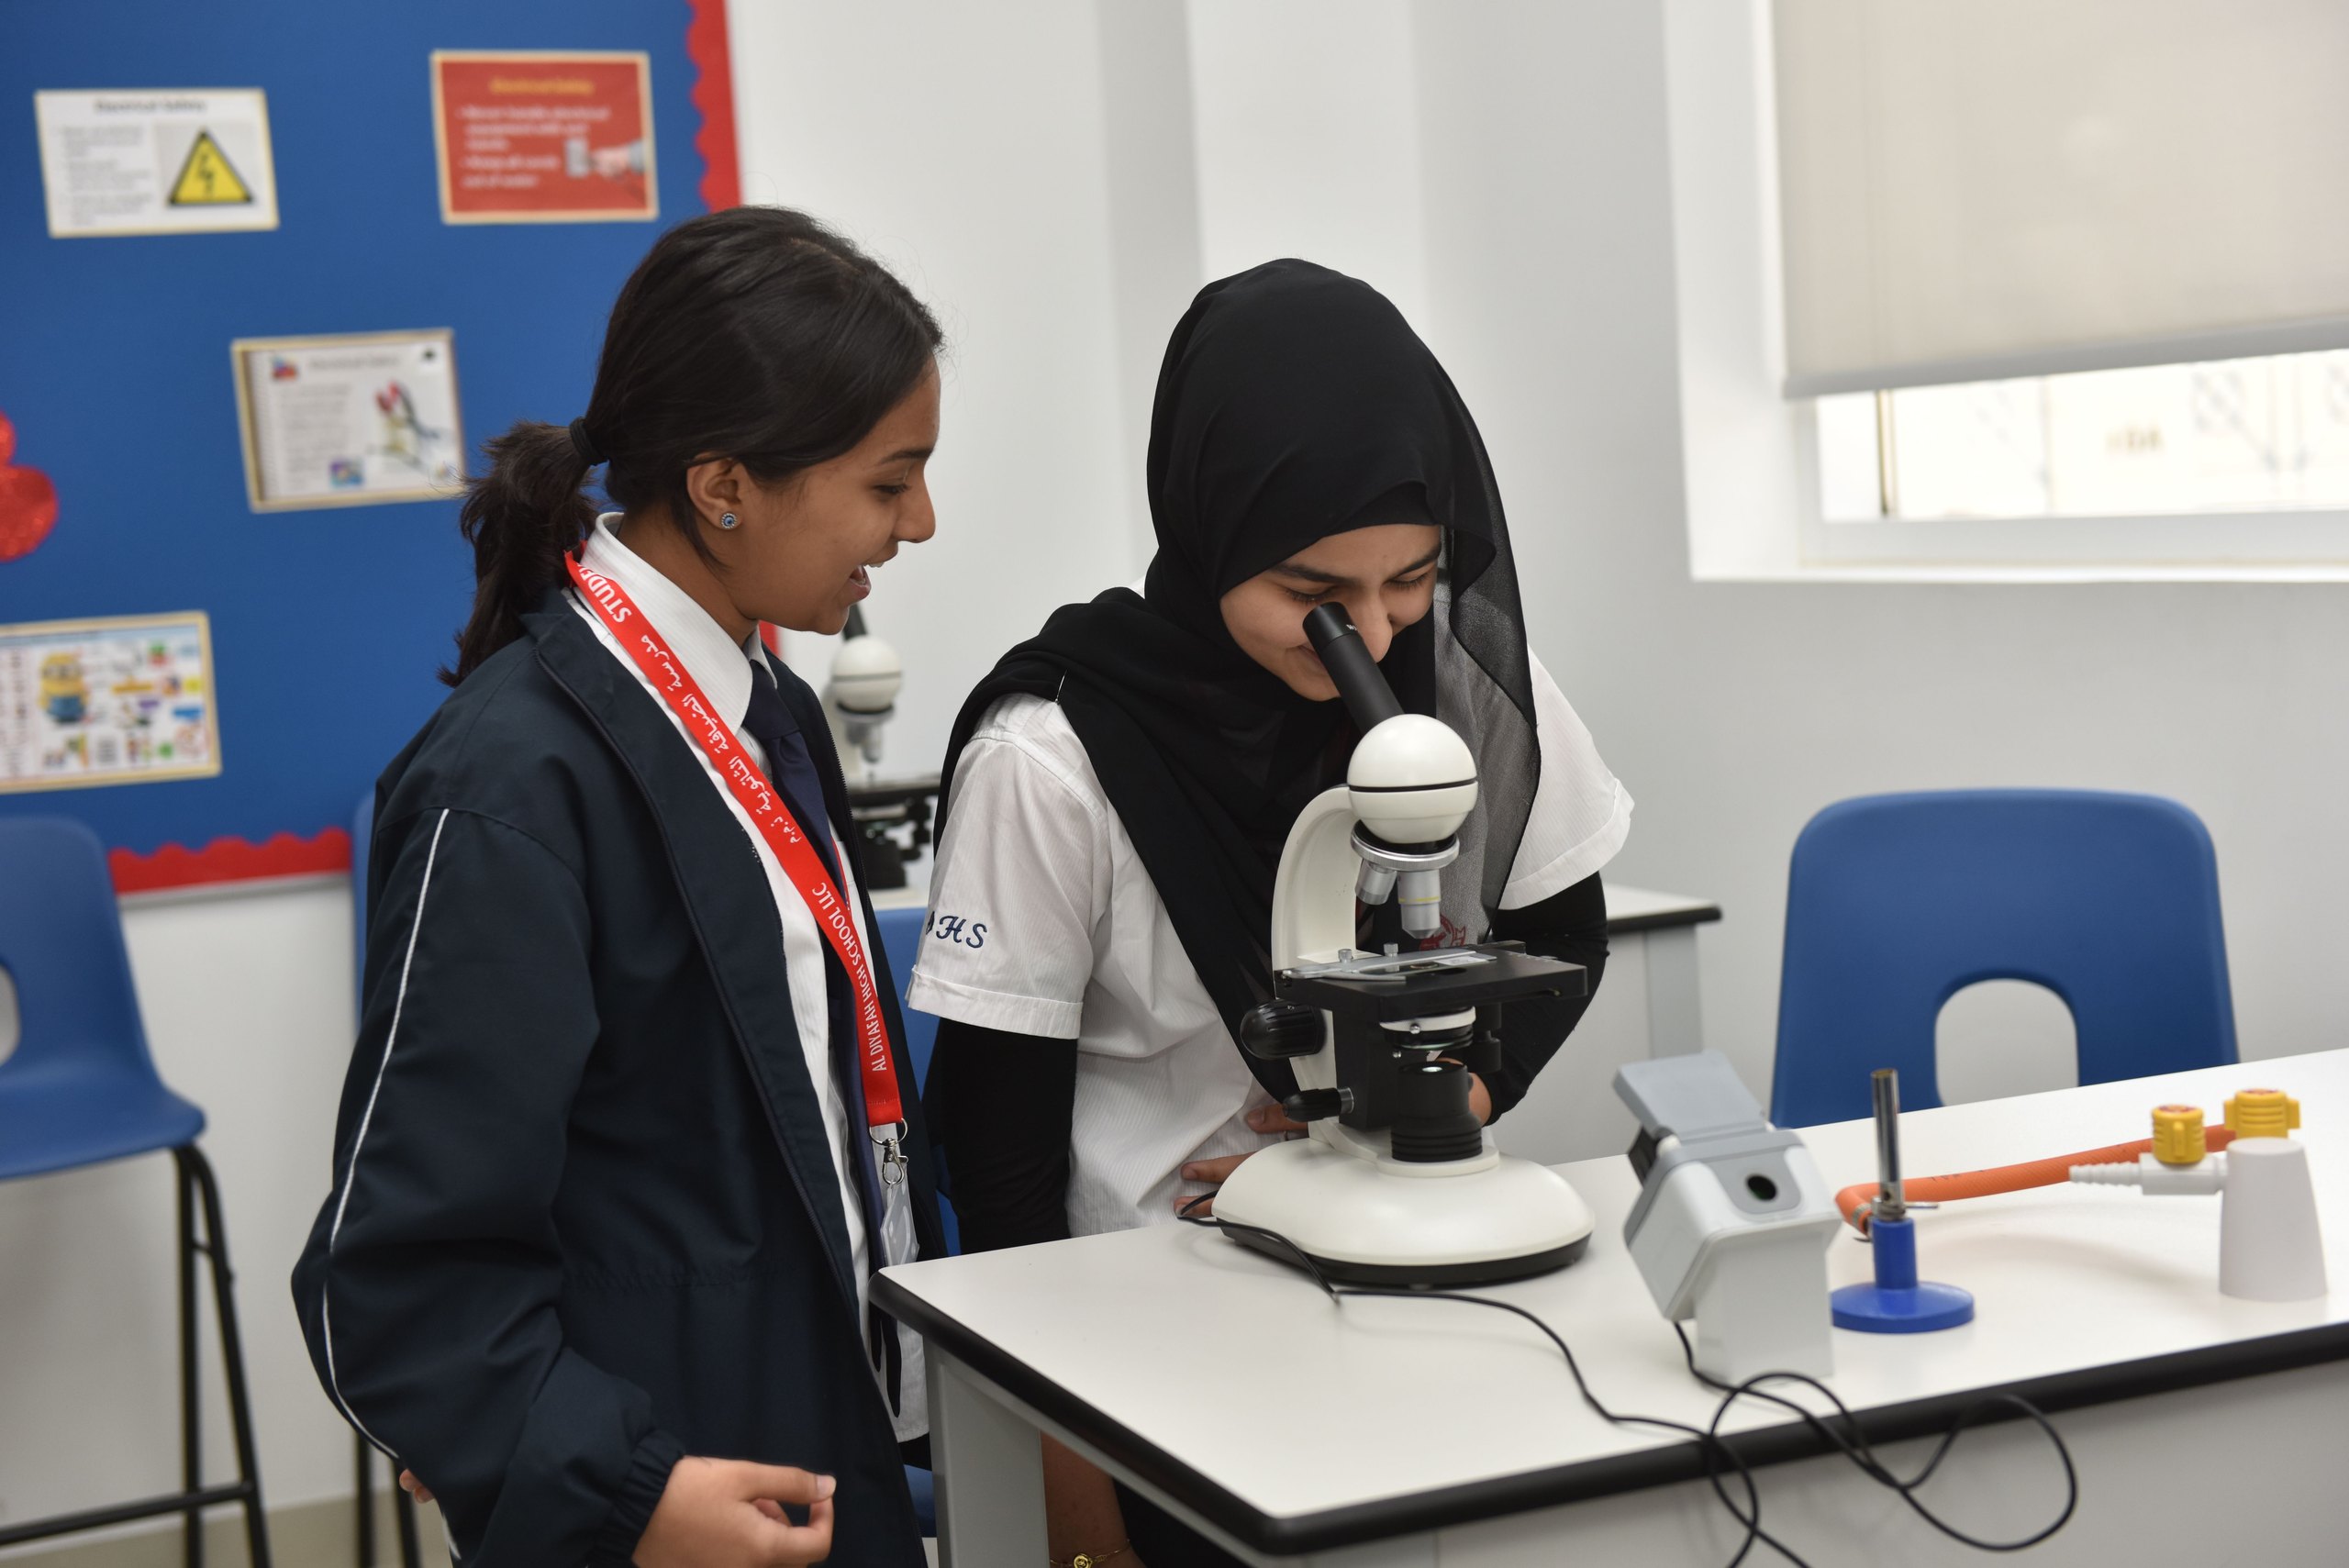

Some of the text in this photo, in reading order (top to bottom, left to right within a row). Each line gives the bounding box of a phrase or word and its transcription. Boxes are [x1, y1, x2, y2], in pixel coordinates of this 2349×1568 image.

[640, 634, 683, 692] مدرسة
[682, 693, 729, 754] الضيافة
[728, 755, 772, 815] الثانوية
[812, 882, 887, 1072] AL DIYAFAH HIGH SCHOOL LLC
